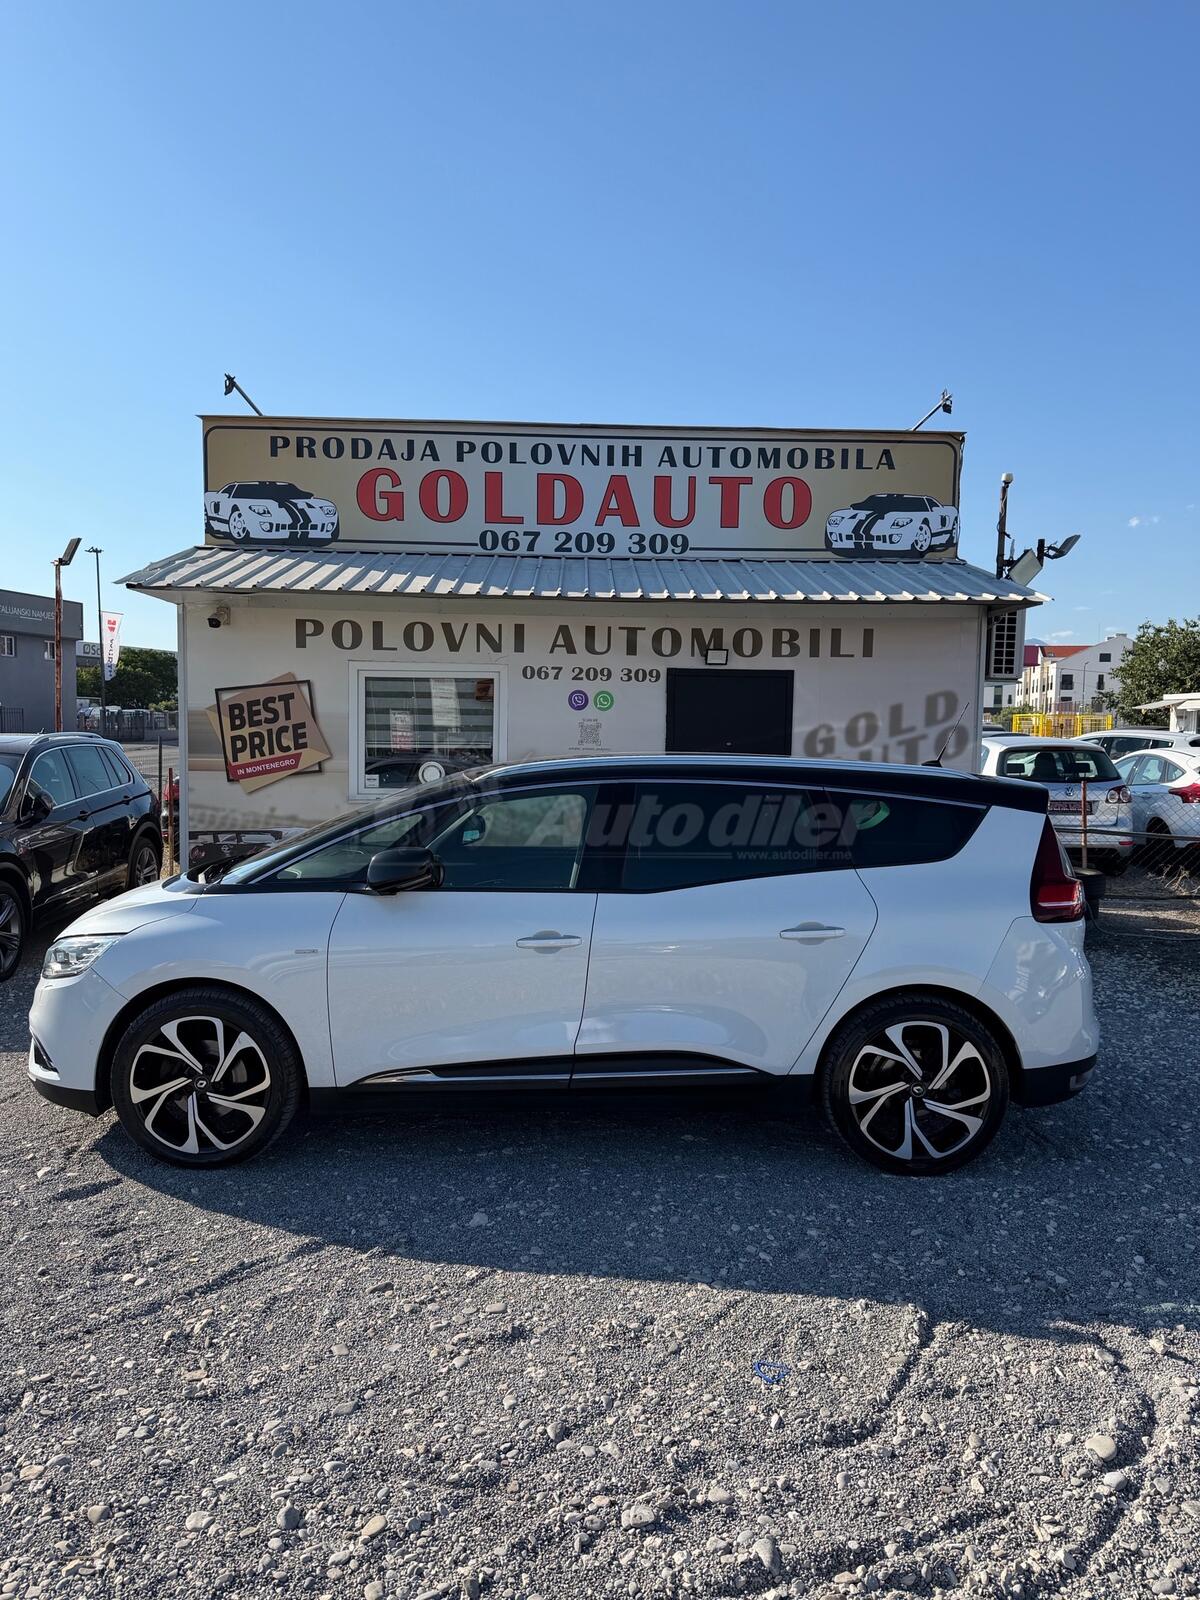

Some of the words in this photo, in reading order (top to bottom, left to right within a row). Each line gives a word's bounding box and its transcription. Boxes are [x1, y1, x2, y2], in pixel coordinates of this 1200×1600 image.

[269, 435, 441, 462] PRODAJA
[456, 440, 643, 467] POLOVNIH
[658, 446, 896, 470] AUTOMOBILA
[356, 467, 812, 529] GOLDAUTO
[479, 530, 541, 551] 067
[554, 531, 615, 553] 209
[628, 533, 689, 554] 309
[295, 618, 526, 654] POLOVNI
[549, 624, 874, 658] AUTOMOBILI
[522, 666, 563, 680] 067
[571, 667, 612, 681] 209
[620, 668, 661, 682] 309
[228, 692, 295, 731] BEST
[803, 689, 959, 758] GOLD
[230, 722, 308, 763] PRICE
[246, 759, 295, 773] MONTENEGRO
